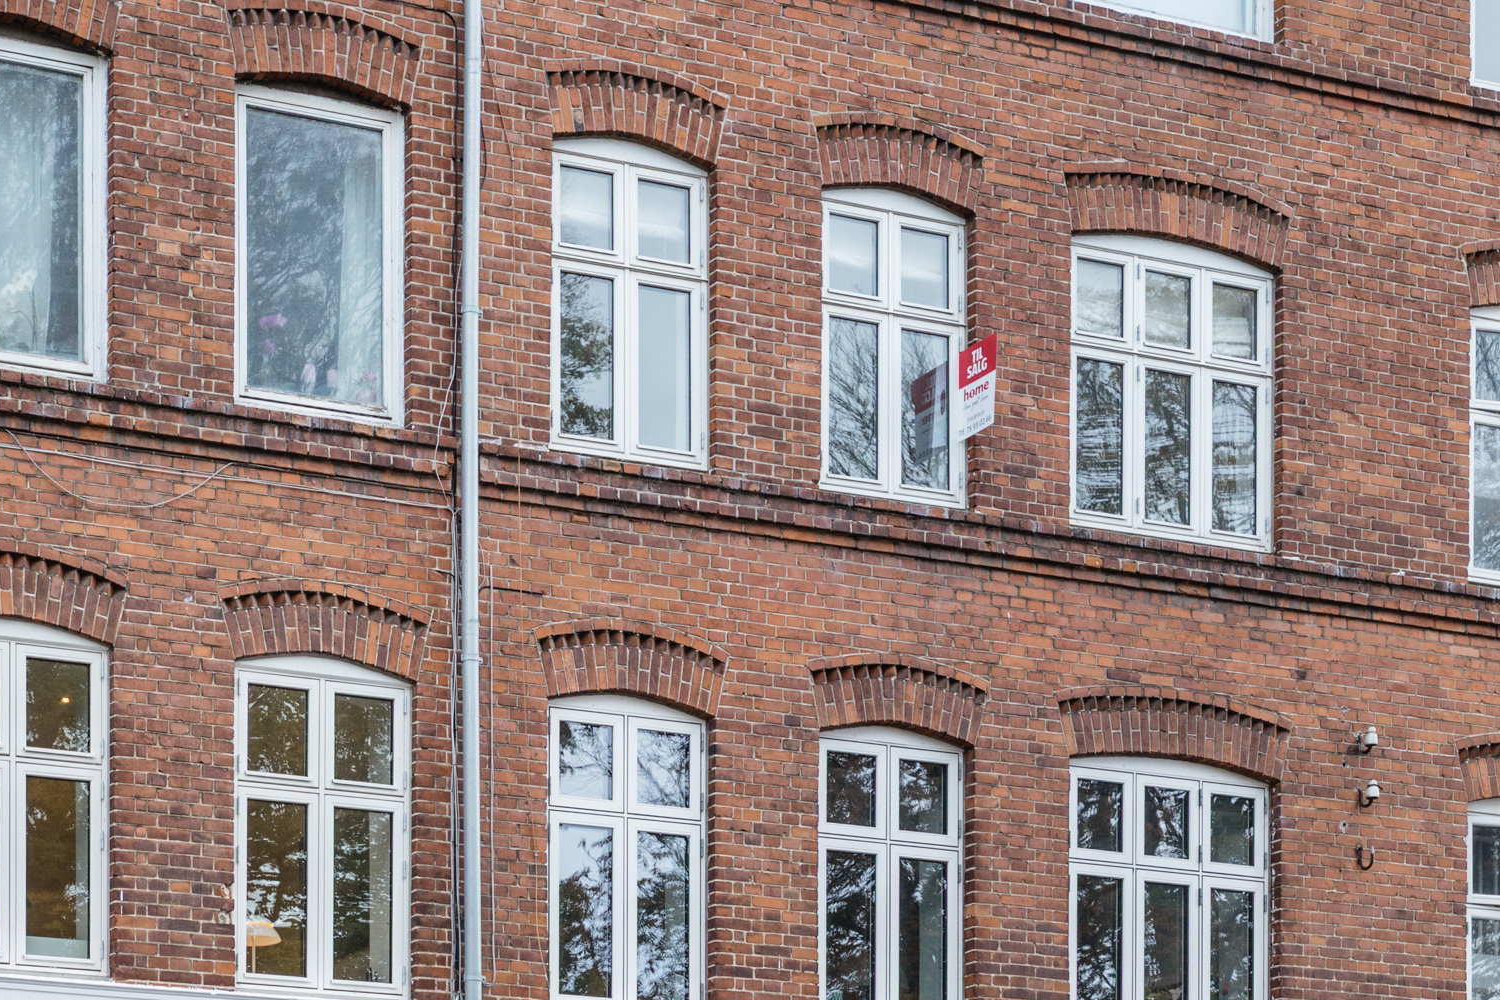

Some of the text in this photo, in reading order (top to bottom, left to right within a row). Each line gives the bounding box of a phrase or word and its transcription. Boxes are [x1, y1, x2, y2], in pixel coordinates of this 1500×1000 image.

[971, 346, 984, 363] TIL
[966, 356, 988, 379] SALG
[963, 380, 990, 402] home
